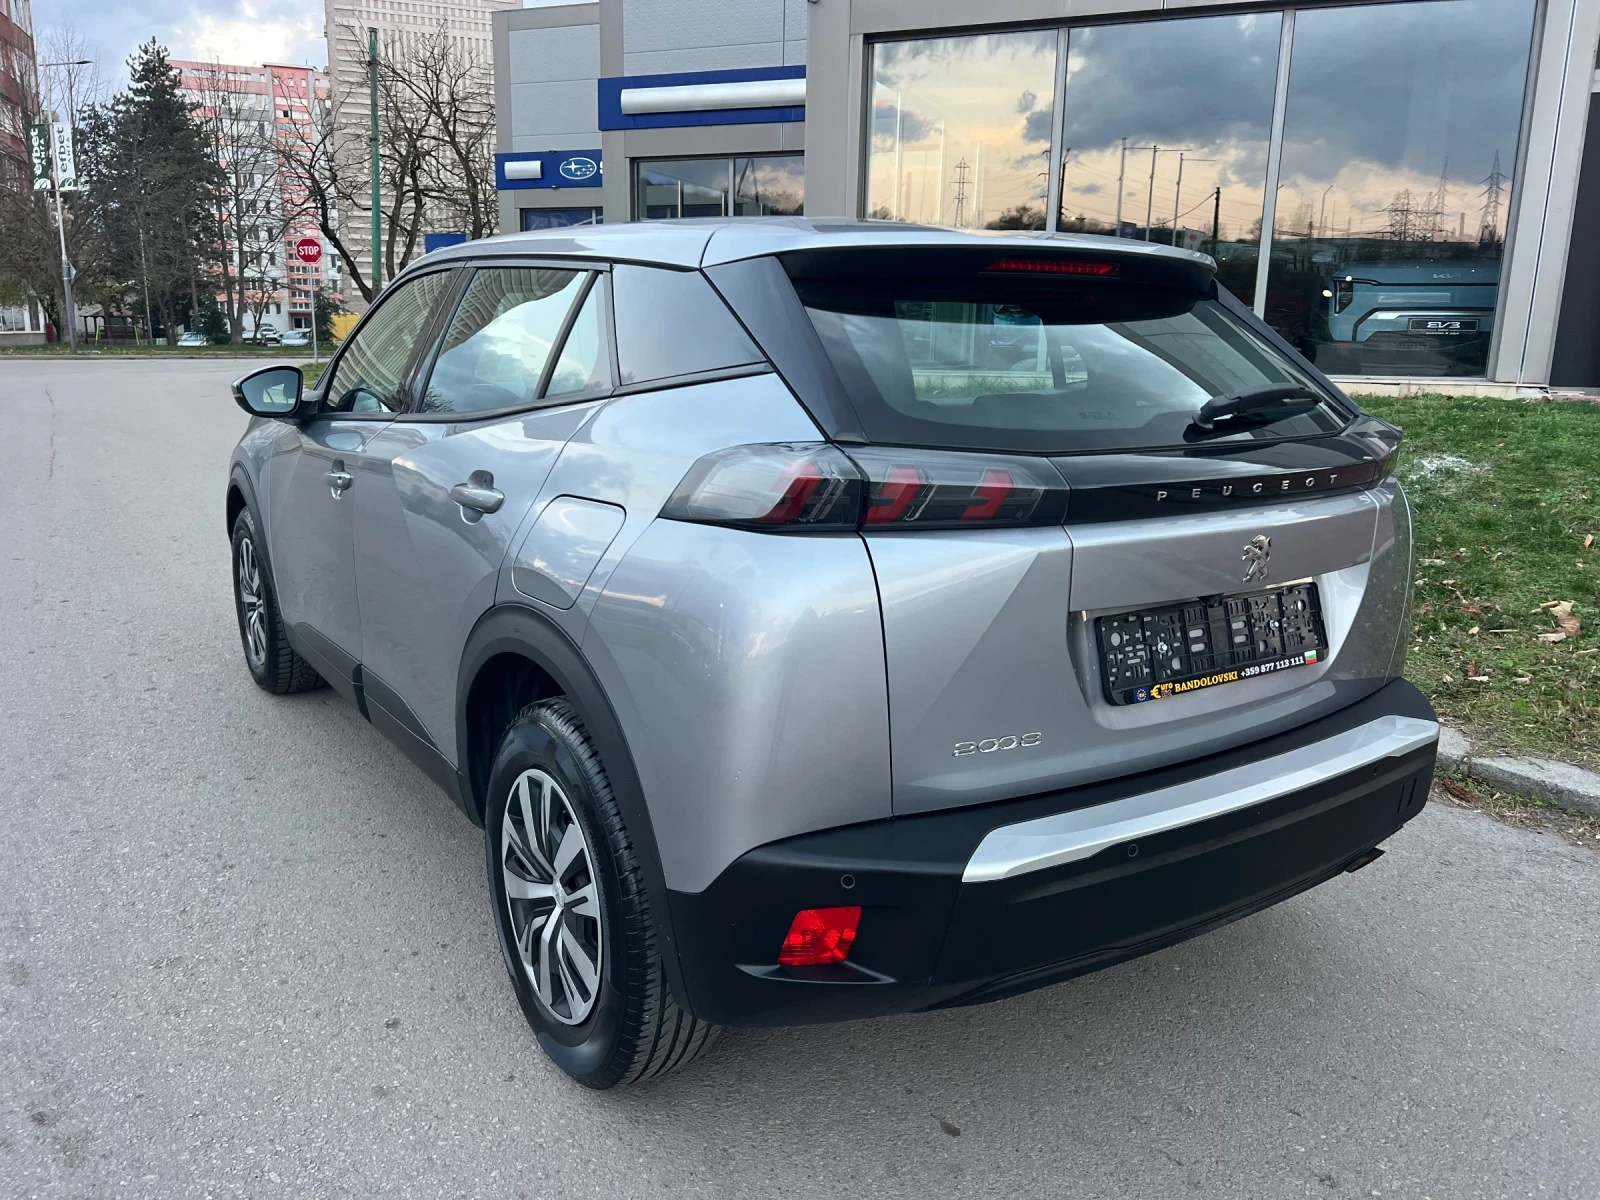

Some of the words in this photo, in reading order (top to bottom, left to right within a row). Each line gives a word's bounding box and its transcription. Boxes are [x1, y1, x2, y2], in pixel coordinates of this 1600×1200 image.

[30, 128, 42, 175] efbet
[57, 127, 68, 172] efbet
[299, 246, 320, 256] STOP
[1156, 474, 1338, 502] PEUGEOT
[1174, 670, 1239, 693] BANDOLOVSKI
[1240, 665, 1260, 678] +359
[1260, 662, 1275, 674] 877
[1275, 659, 1290, 671] 113
[1290, 656, 1305, 667] 111
[952, 730, 1042, 757] 2008
